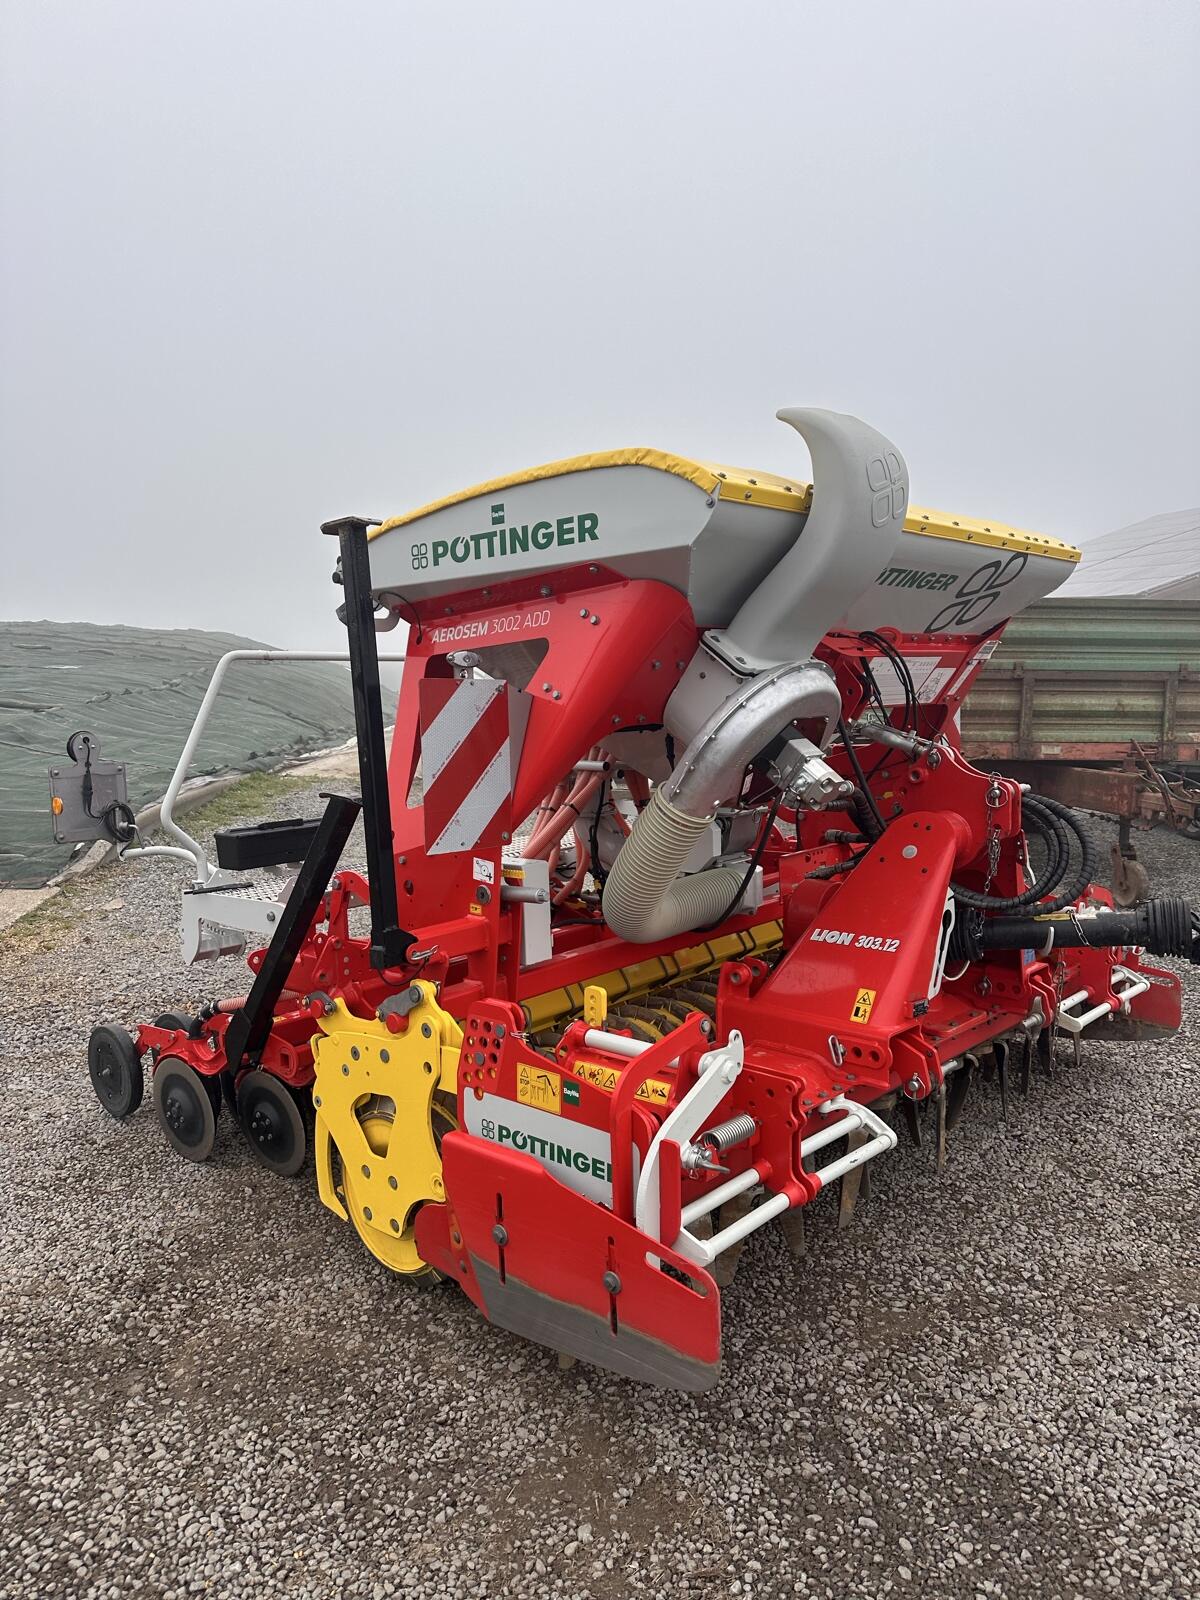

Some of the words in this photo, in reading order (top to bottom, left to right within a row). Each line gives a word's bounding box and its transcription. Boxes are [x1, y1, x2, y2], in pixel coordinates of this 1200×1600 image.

[432, 513, 600, 566] PÖTTINGER
[431, 622, 488, 643] AEROSEM
[490, 616, 521, 634] 3002
[523, 610, 551, 629] ADD
[810, 929, 855, 946] LION
[855, 935, 900, 953] 303.12
